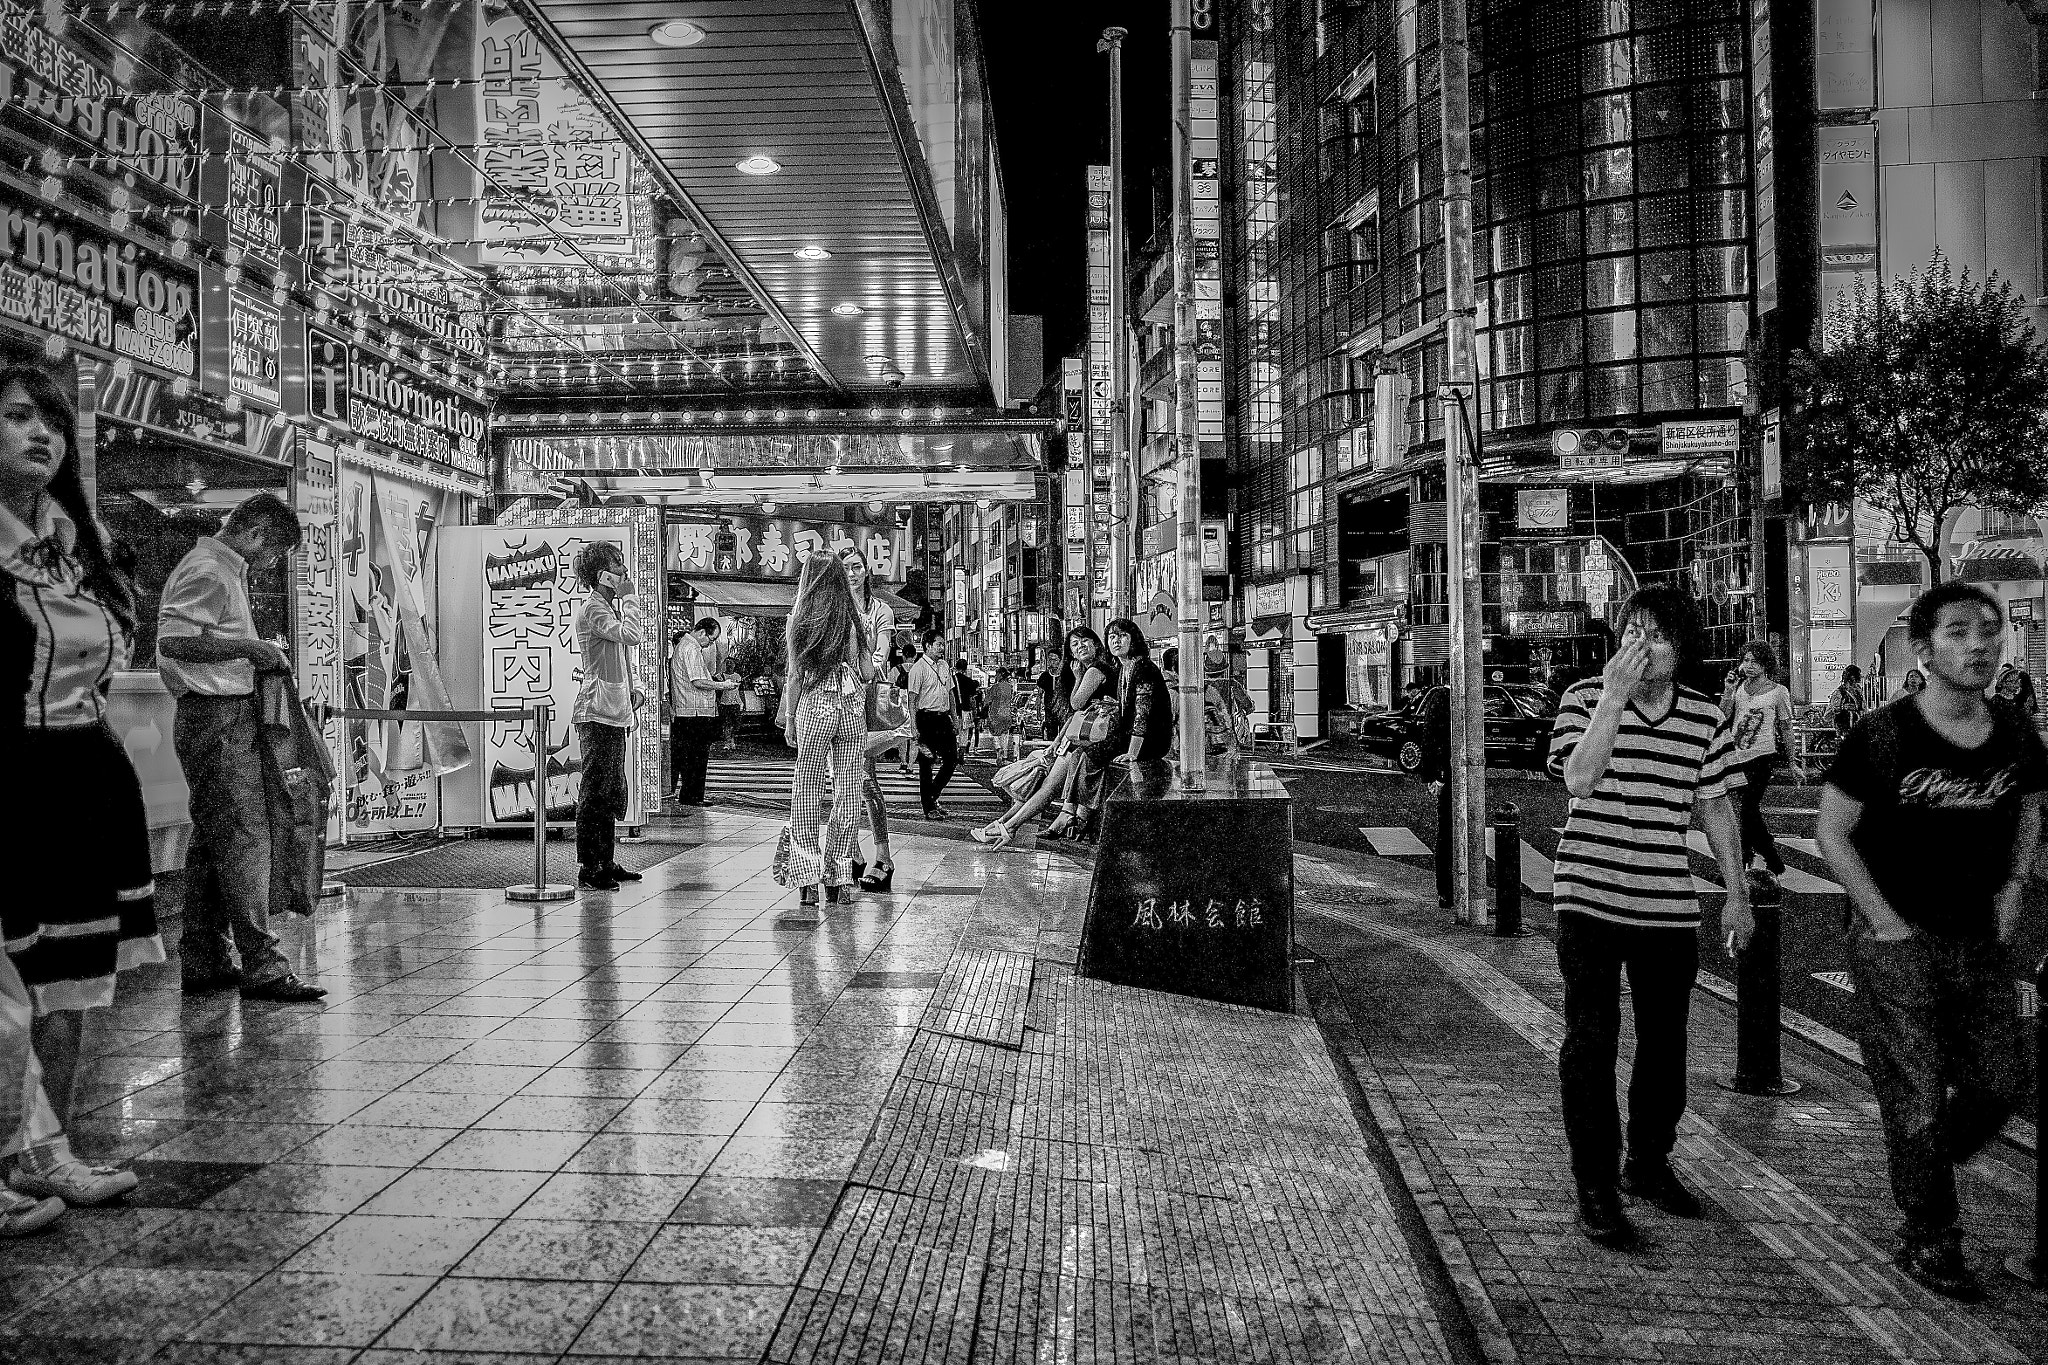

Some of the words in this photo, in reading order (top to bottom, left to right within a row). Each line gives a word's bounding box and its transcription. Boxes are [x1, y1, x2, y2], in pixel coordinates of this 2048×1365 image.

[1823, 149, 1871, 160] ダイヤモンド
[0, 263, 112, 347] 無料案内
[136, 307, 177, 344] CLUB
[115, 323, 194, 375] MAN-ZOKU
[351, 349, 484, 440] information
[1665, 424, 1736, 440] 新宿区役所通り
[1563, 457, 1621, 467] 自転車専用
[487, 555, 555, 582] MAN-ZOKU
[306, 452, 337, 750] 無料案内
[489, 587, 555, 748] 案内所
[491, 769, 583, 819] MAN-ZO
[1131, 898, 1263, 930] 風林会館
